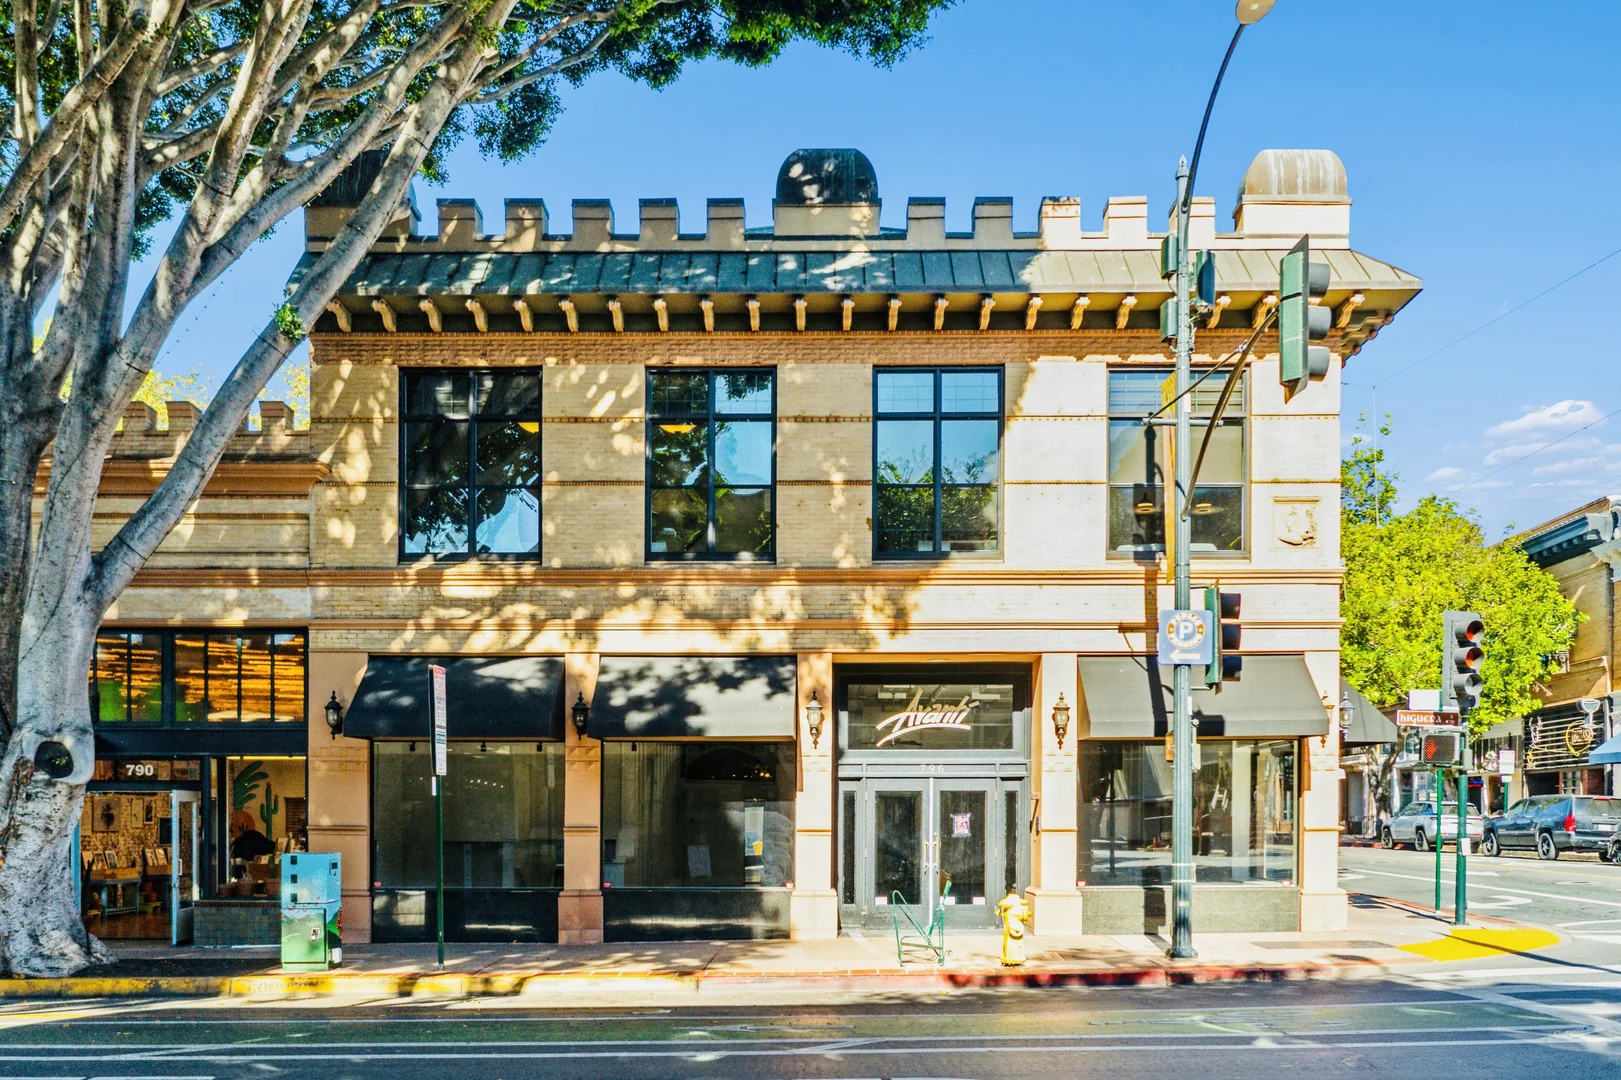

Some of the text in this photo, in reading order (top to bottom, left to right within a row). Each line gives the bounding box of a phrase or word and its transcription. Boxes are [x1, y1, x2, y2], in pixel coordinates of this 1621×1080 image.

[1179, 621, 1194, 640] P
[876, 688, 979, 741] Avanti
[125, 764, 154, 776] 790
[920, 764, 945, 773] 796
